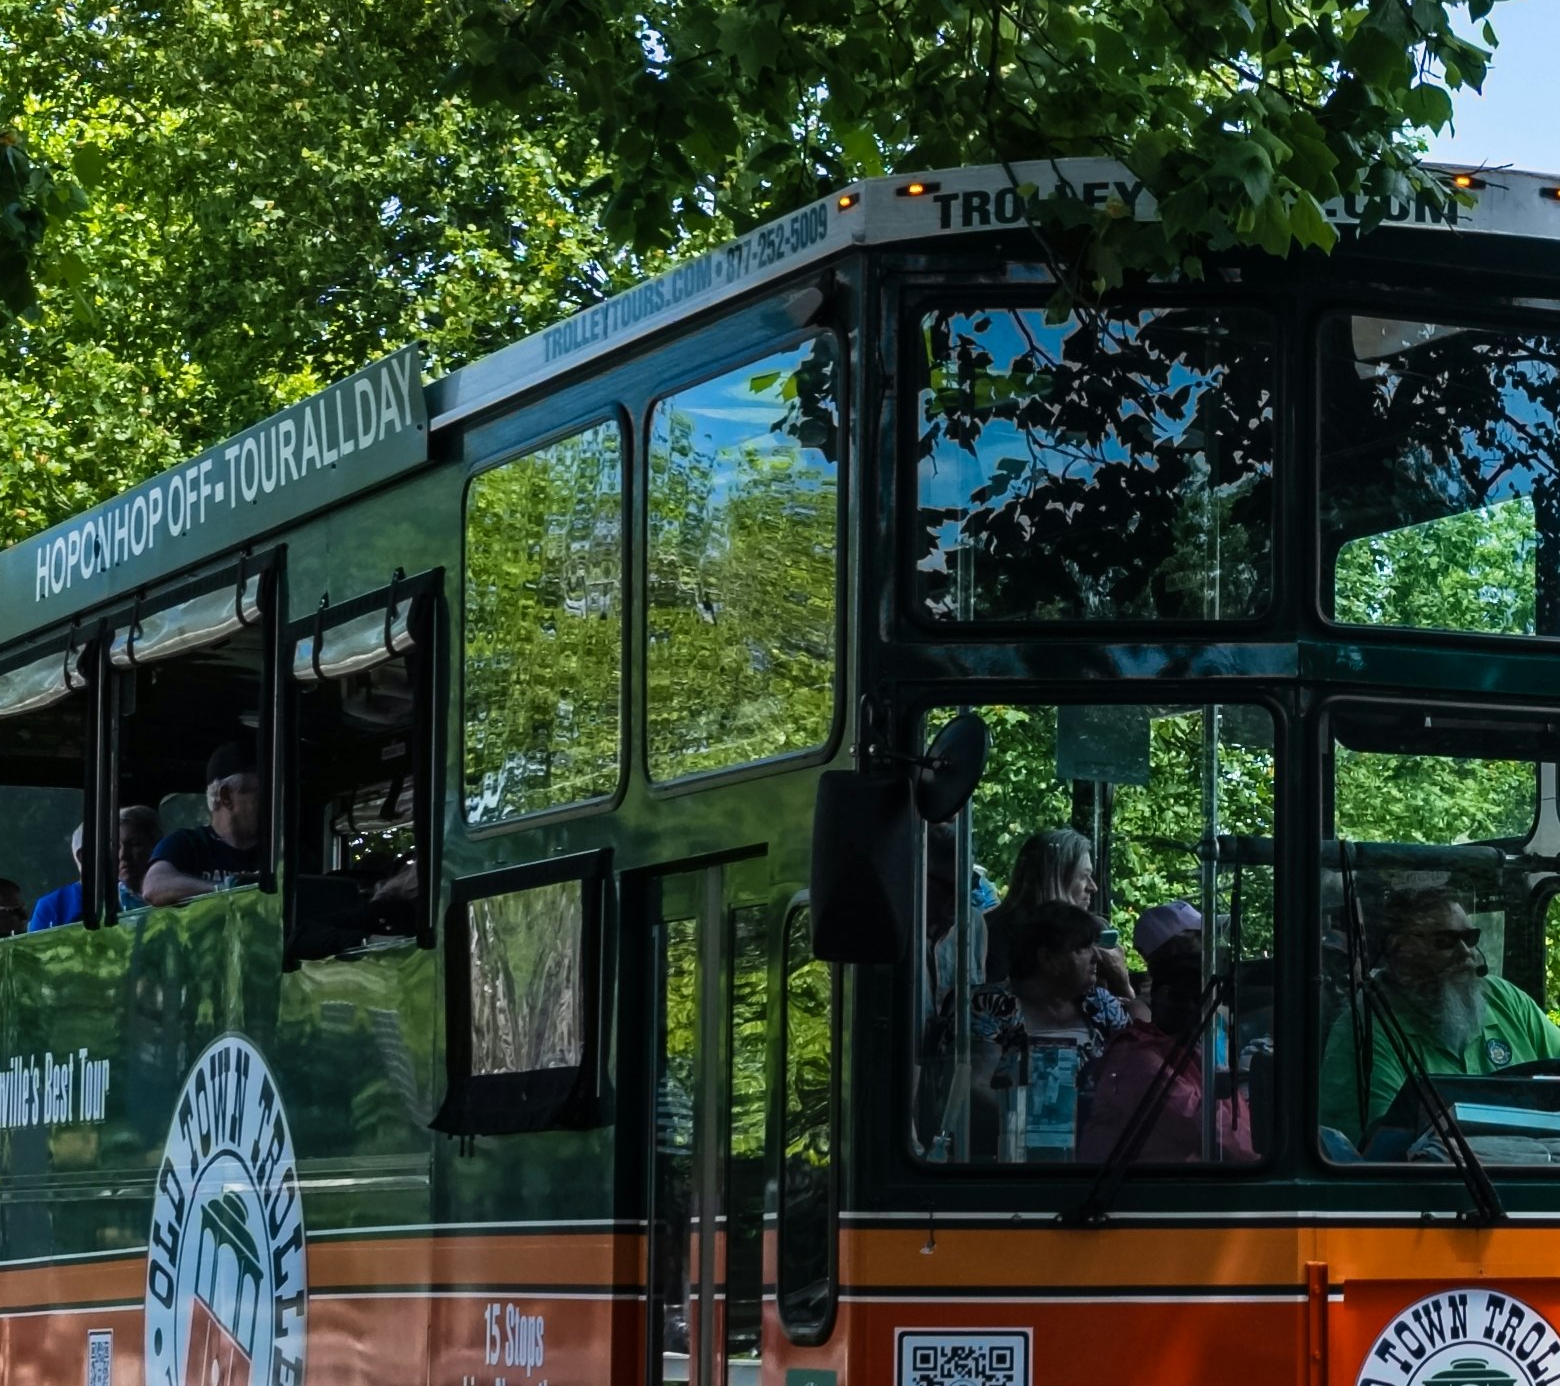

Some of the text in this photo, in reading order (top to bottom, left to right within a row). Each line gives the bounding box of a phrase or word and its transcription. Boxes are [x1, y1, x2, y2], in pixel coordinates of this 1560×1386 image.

[543, 202, 828, 363] TROLLEYTOURS.COM 877-252-5009
[44, 1052, 74, 1125] Best
[79, 1048, 110, 1123] Tour
[149, 1156, 185, 1310] OLD
[179, 1047, 250, 1180] TOWN
[484, 1302, 544, 1377] 15 Stops
[1374, 1293, 1468, 1375] TOWN
